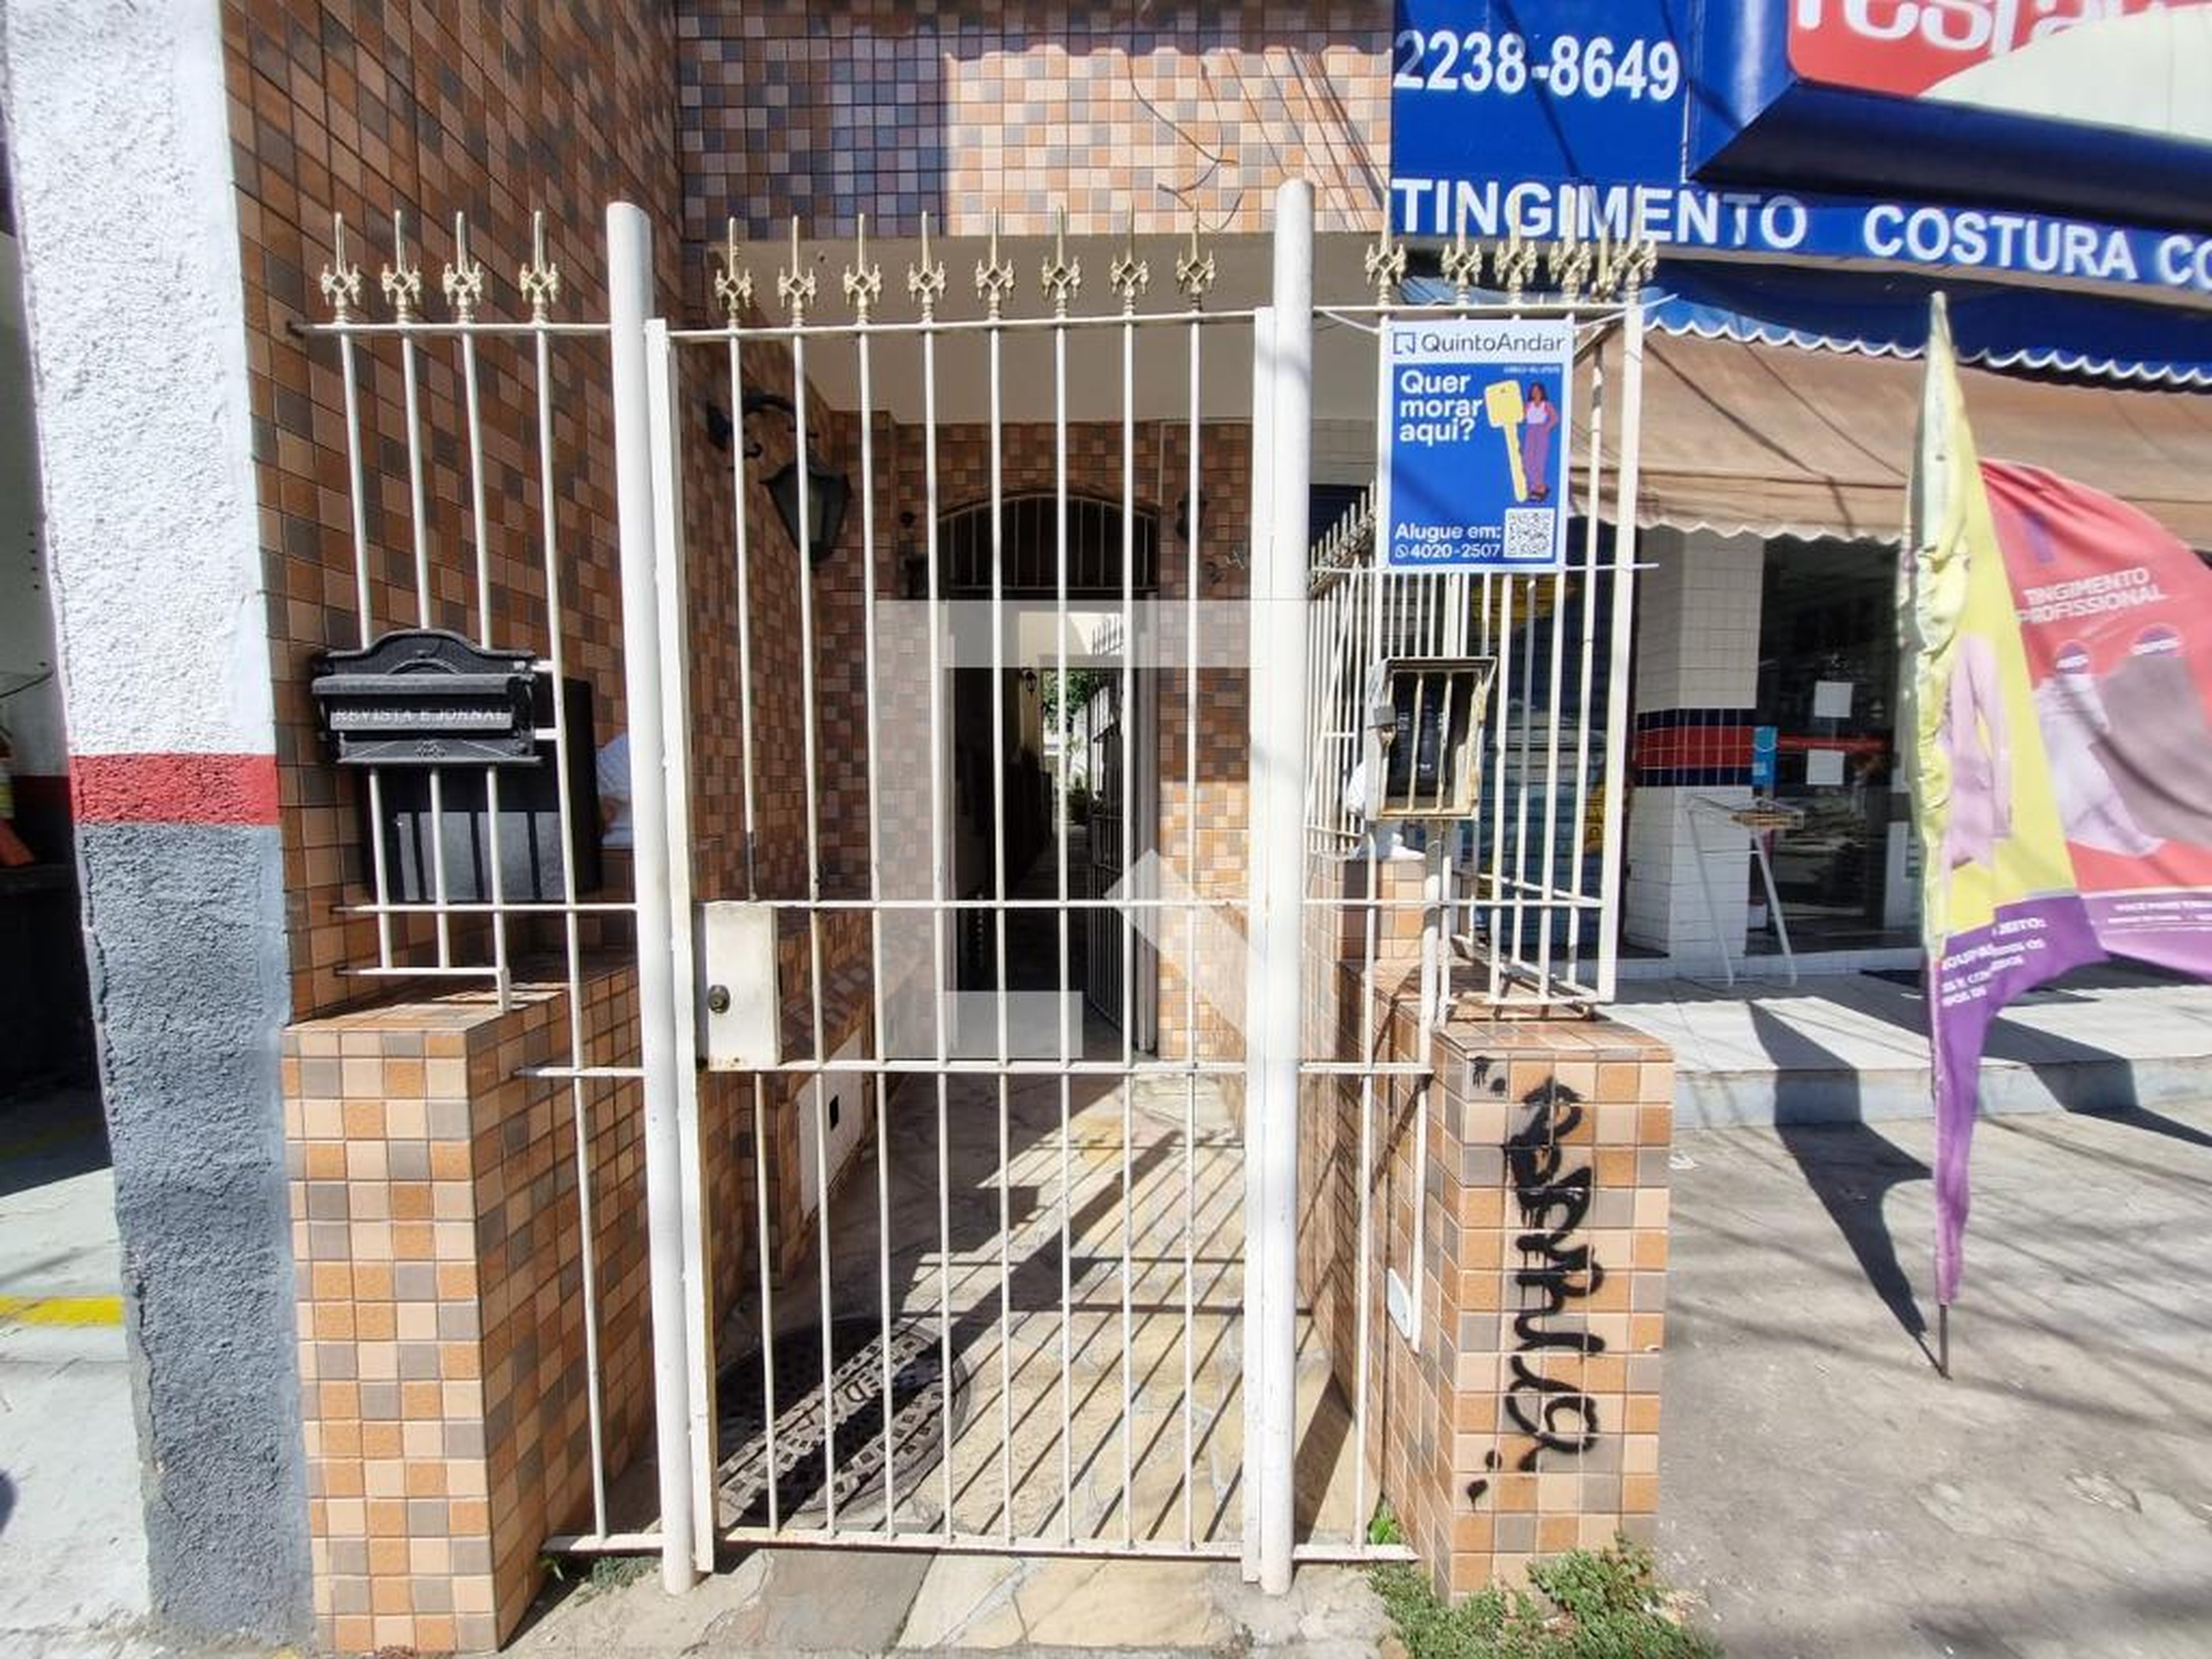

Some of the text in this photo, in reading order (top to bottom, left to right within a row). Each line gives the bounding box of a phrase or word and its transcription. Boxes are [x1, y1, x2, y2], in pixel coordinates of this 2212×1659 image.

[1393, 30, 1679, 101] 2238-8649
[1391, 178, 1808, 249] TINGIMENTO
[1863, 205, 2139, 280] COSTURA
[1421, 332, 1564, 353] QuintoAndar
[1401, 369, 1471, 394] Quer
[1400, 399, 1483, 418] morar
[1400, 418, 1475, 446] aqui?
[1395, 522, 1502, 543] Alugue em:
[1410, 543, 1501, 558] 4020-2507
